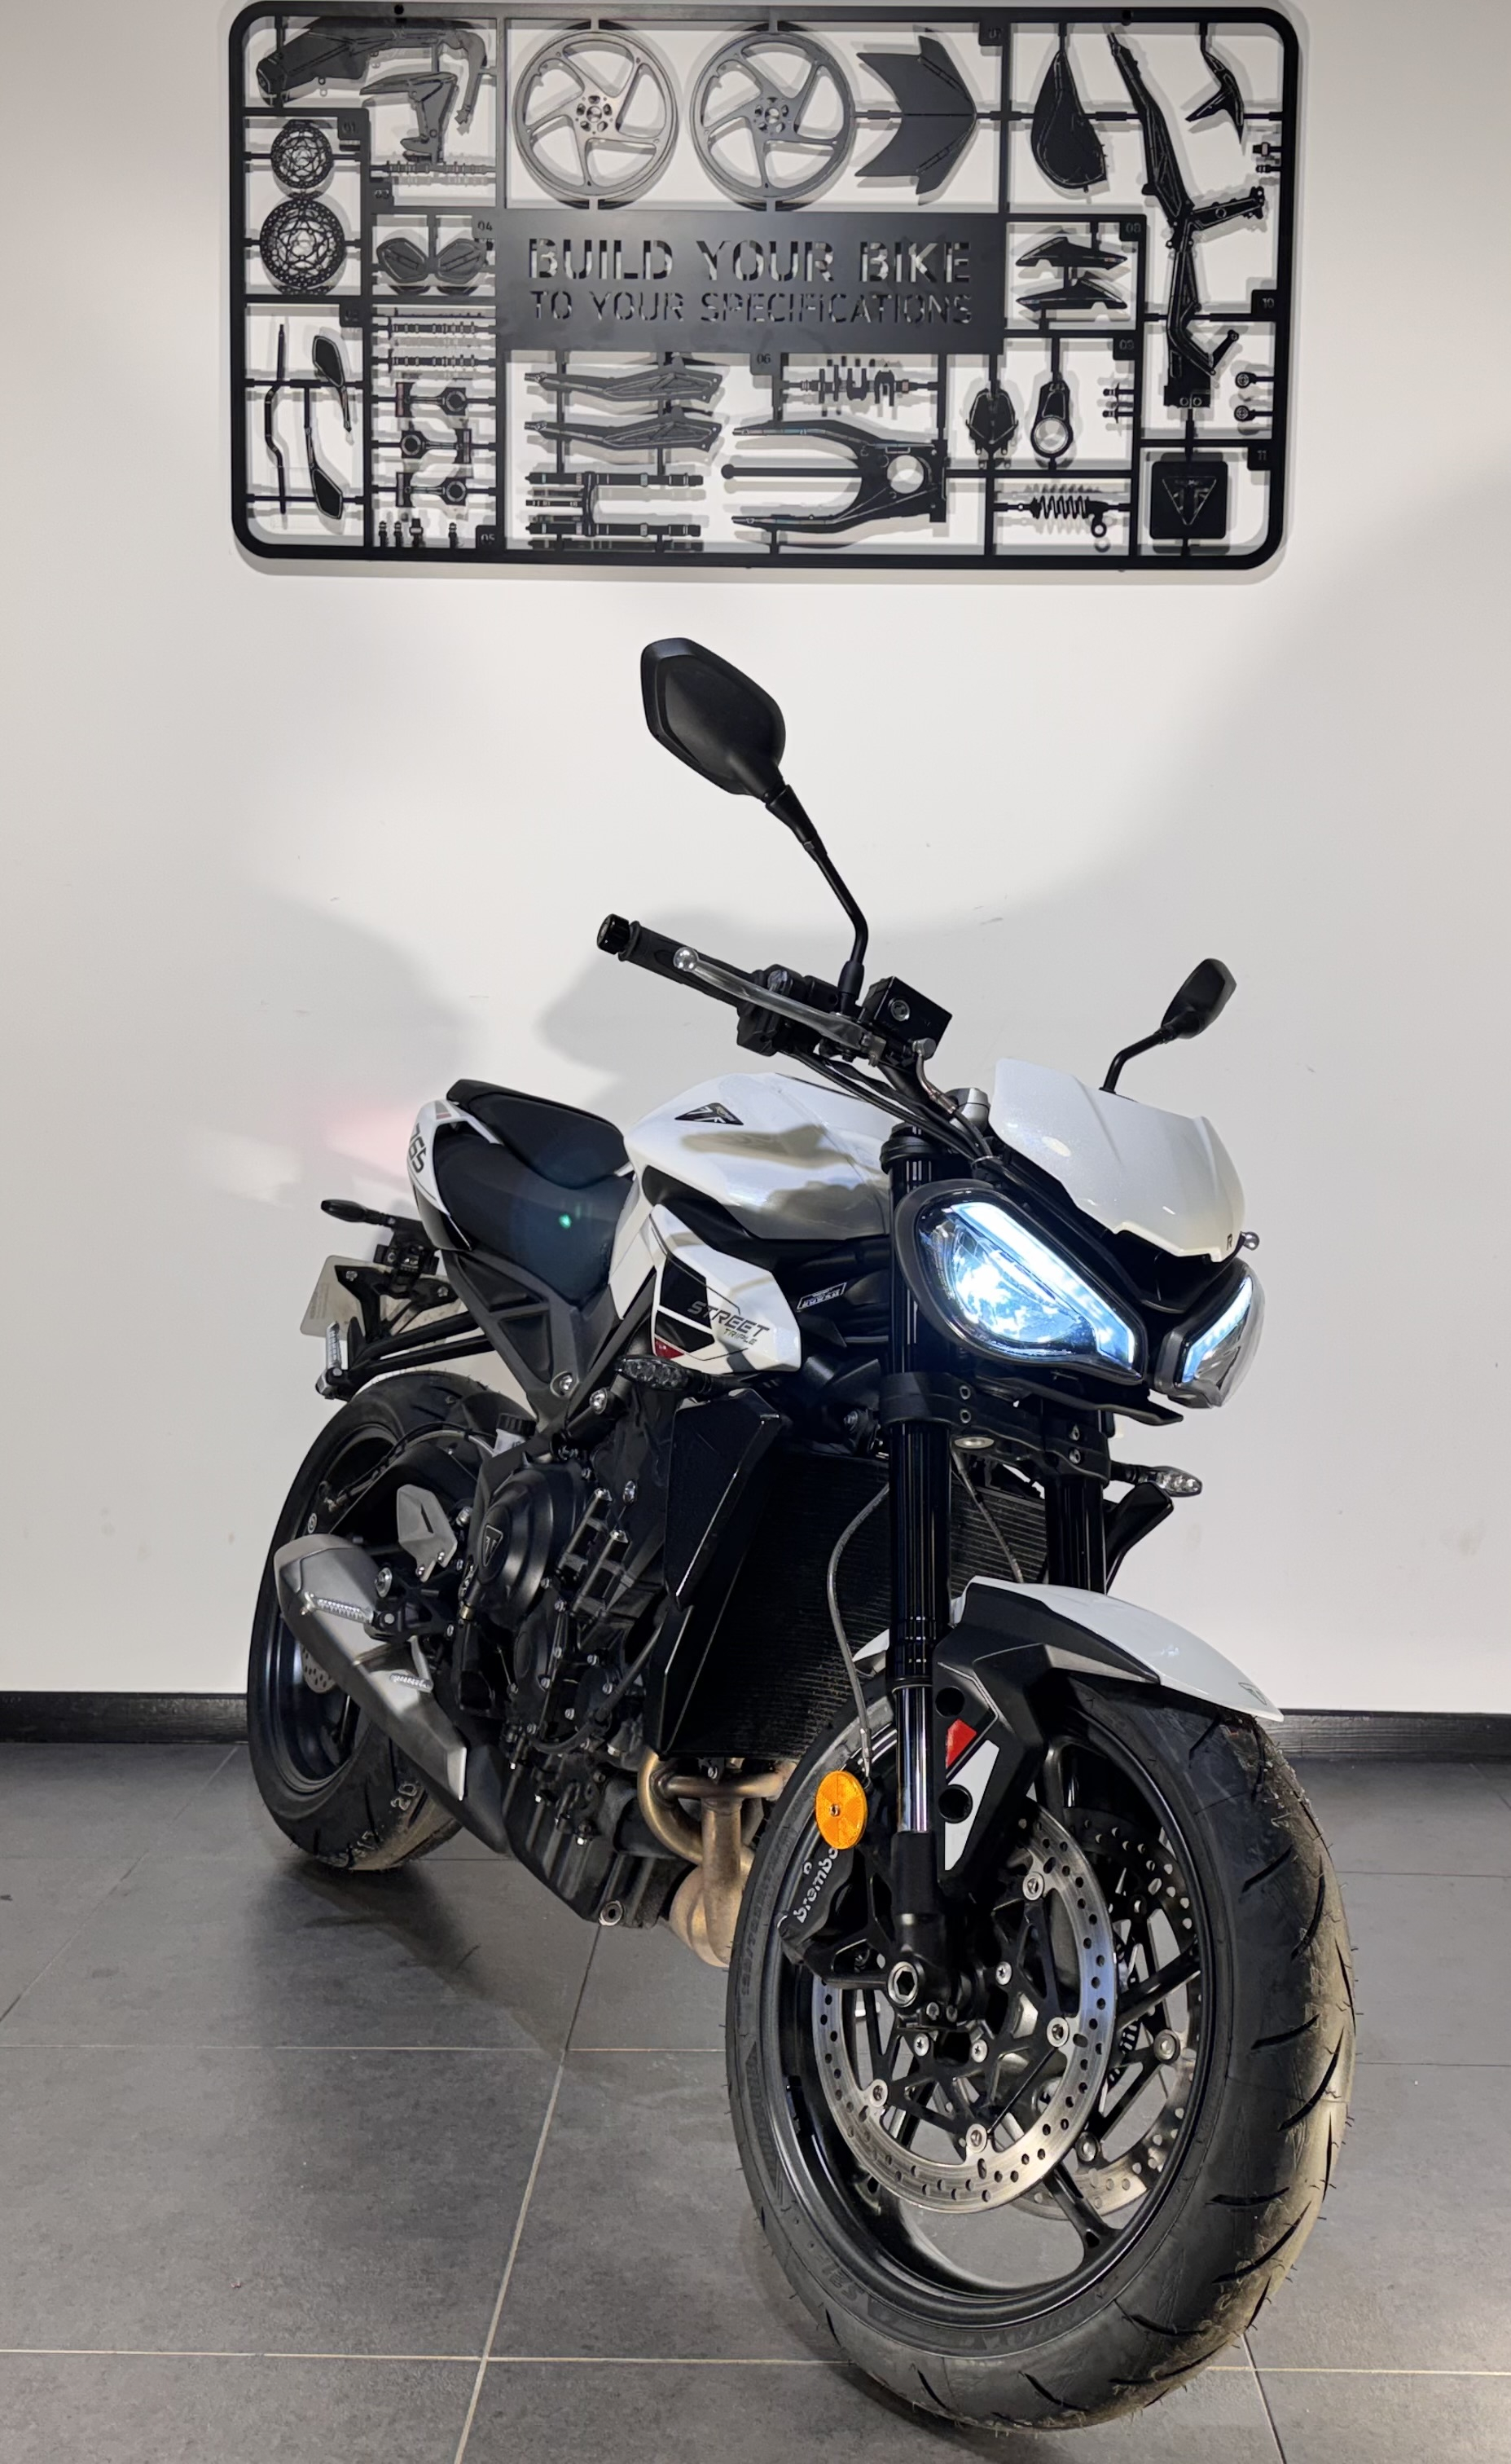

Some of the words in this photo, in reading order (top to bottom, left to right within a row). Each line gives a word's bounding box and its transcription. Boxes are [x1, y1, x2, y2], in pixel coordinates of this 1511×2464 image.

[477, 221, 493, 231] 04
[1125, 222, 1141, 235] 08
[529, 238, 673, 279] BUILD
[696, 240, 834, 282] YOUR
[859, 240, 970, 284] BIKE
[529, 290, 573, 320] TO
[588, 290, 684, 323] YOUR
[700, 292, 973, 324] SPECIFICATIONS
[1262, 297, 1275, 310] 10
[757, 353, 771, 365] 06
[1257, 449, 1268, 462] 11
[481, 533, 496, 545] 05
[408, 1123, 427, 1173] 765
[1226, 1233, 1233, 1252] R
[687, 1300, 770, 1338] STREET
[723, 1327, 758, 1346] TRIPLE
[793, 1846, 839, 1924] brembo
